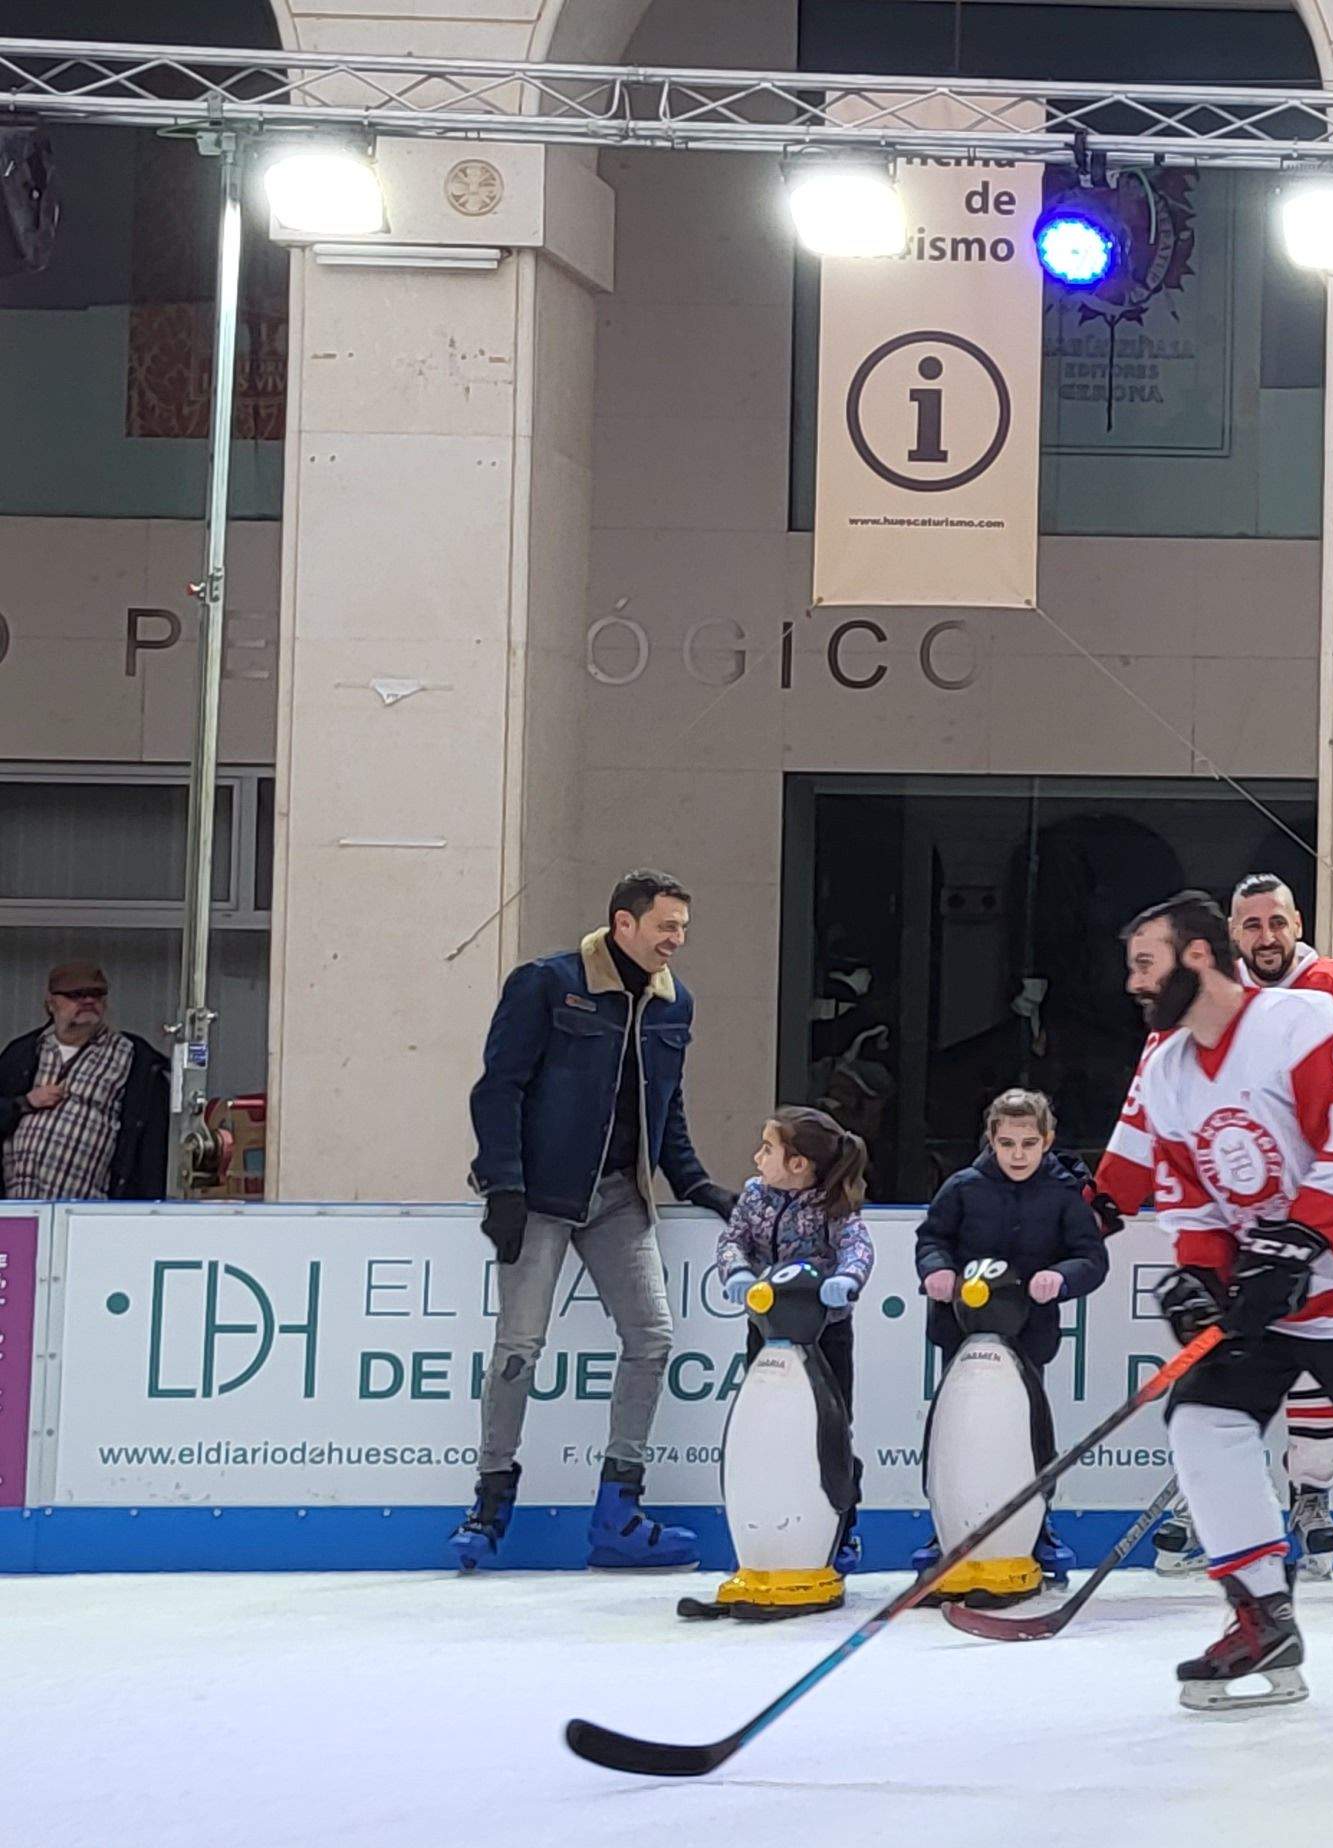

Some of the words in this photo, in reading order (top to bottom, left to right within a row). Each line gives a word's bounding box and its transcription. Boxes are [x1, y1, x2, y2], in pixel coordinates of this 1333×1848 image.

[965, 180, 1017, 216] de
[912, 226, 1016, 262] ismo
[848, 515, 1006, 530] www.huescaturismo.com
[365, 1259, 457, 1317] EL
[358, 1350, 453, 1401] DE
[98, 1441, 480, 1467] www.eldiariodehuesca.co
